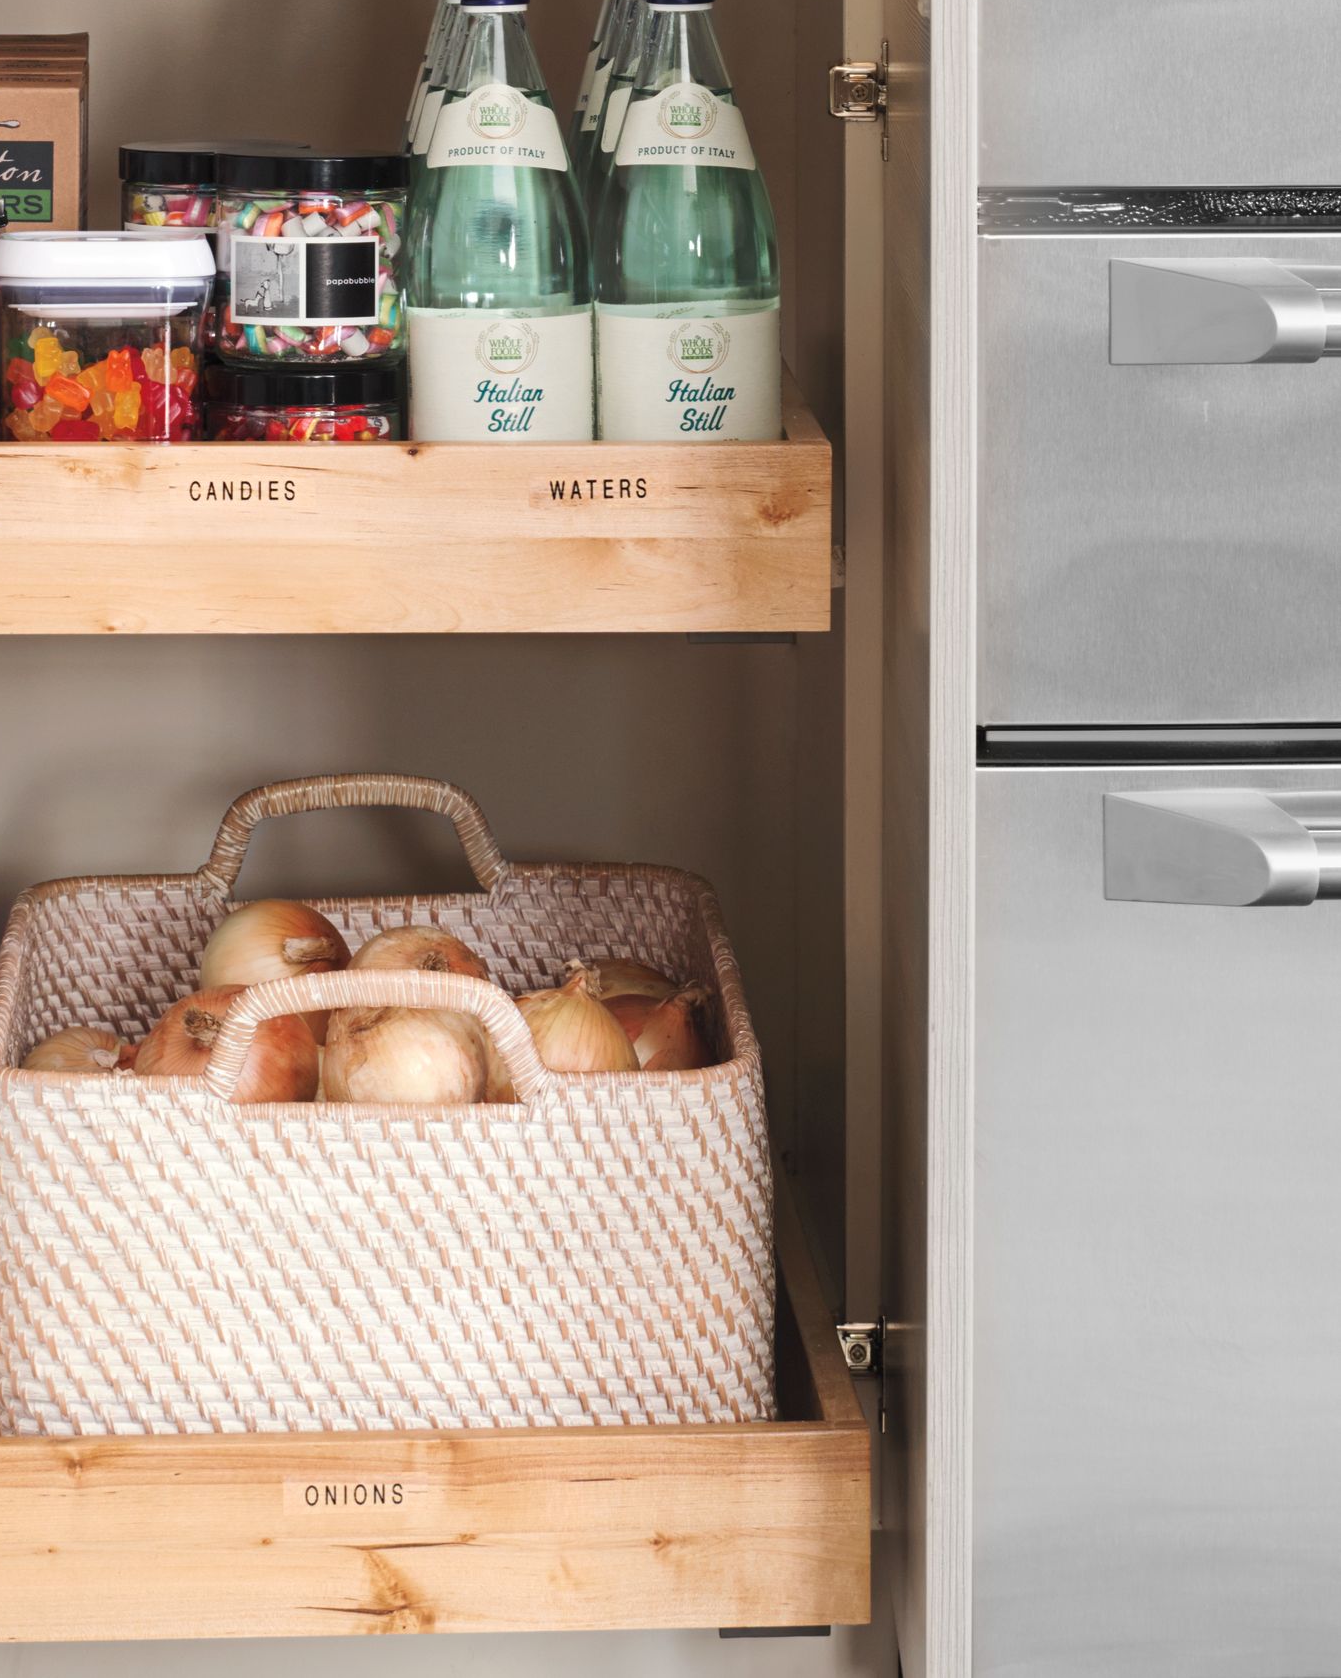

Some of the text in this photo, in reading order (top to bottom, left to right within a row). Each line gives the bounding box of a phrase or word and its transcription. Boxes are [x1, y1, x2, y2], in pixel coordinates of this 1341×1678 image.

[448, 146, 546, 159] PRODUCT OF ITALY
[638, 146, 736, 159] PRODUCT OF ITALY
[326, 277, 375, 286] papabubble
[474, 377, 544, 403] Italian
[665, 376, 737, 403] Italian
[488, 406, 535, 432] Still
[680, 405, 727, 432] Still
[189, 480, 296, 502] CANDIES
[549, 477, 647, 501] WATERS
[304, 1482, 403, 1507] ONIONS
